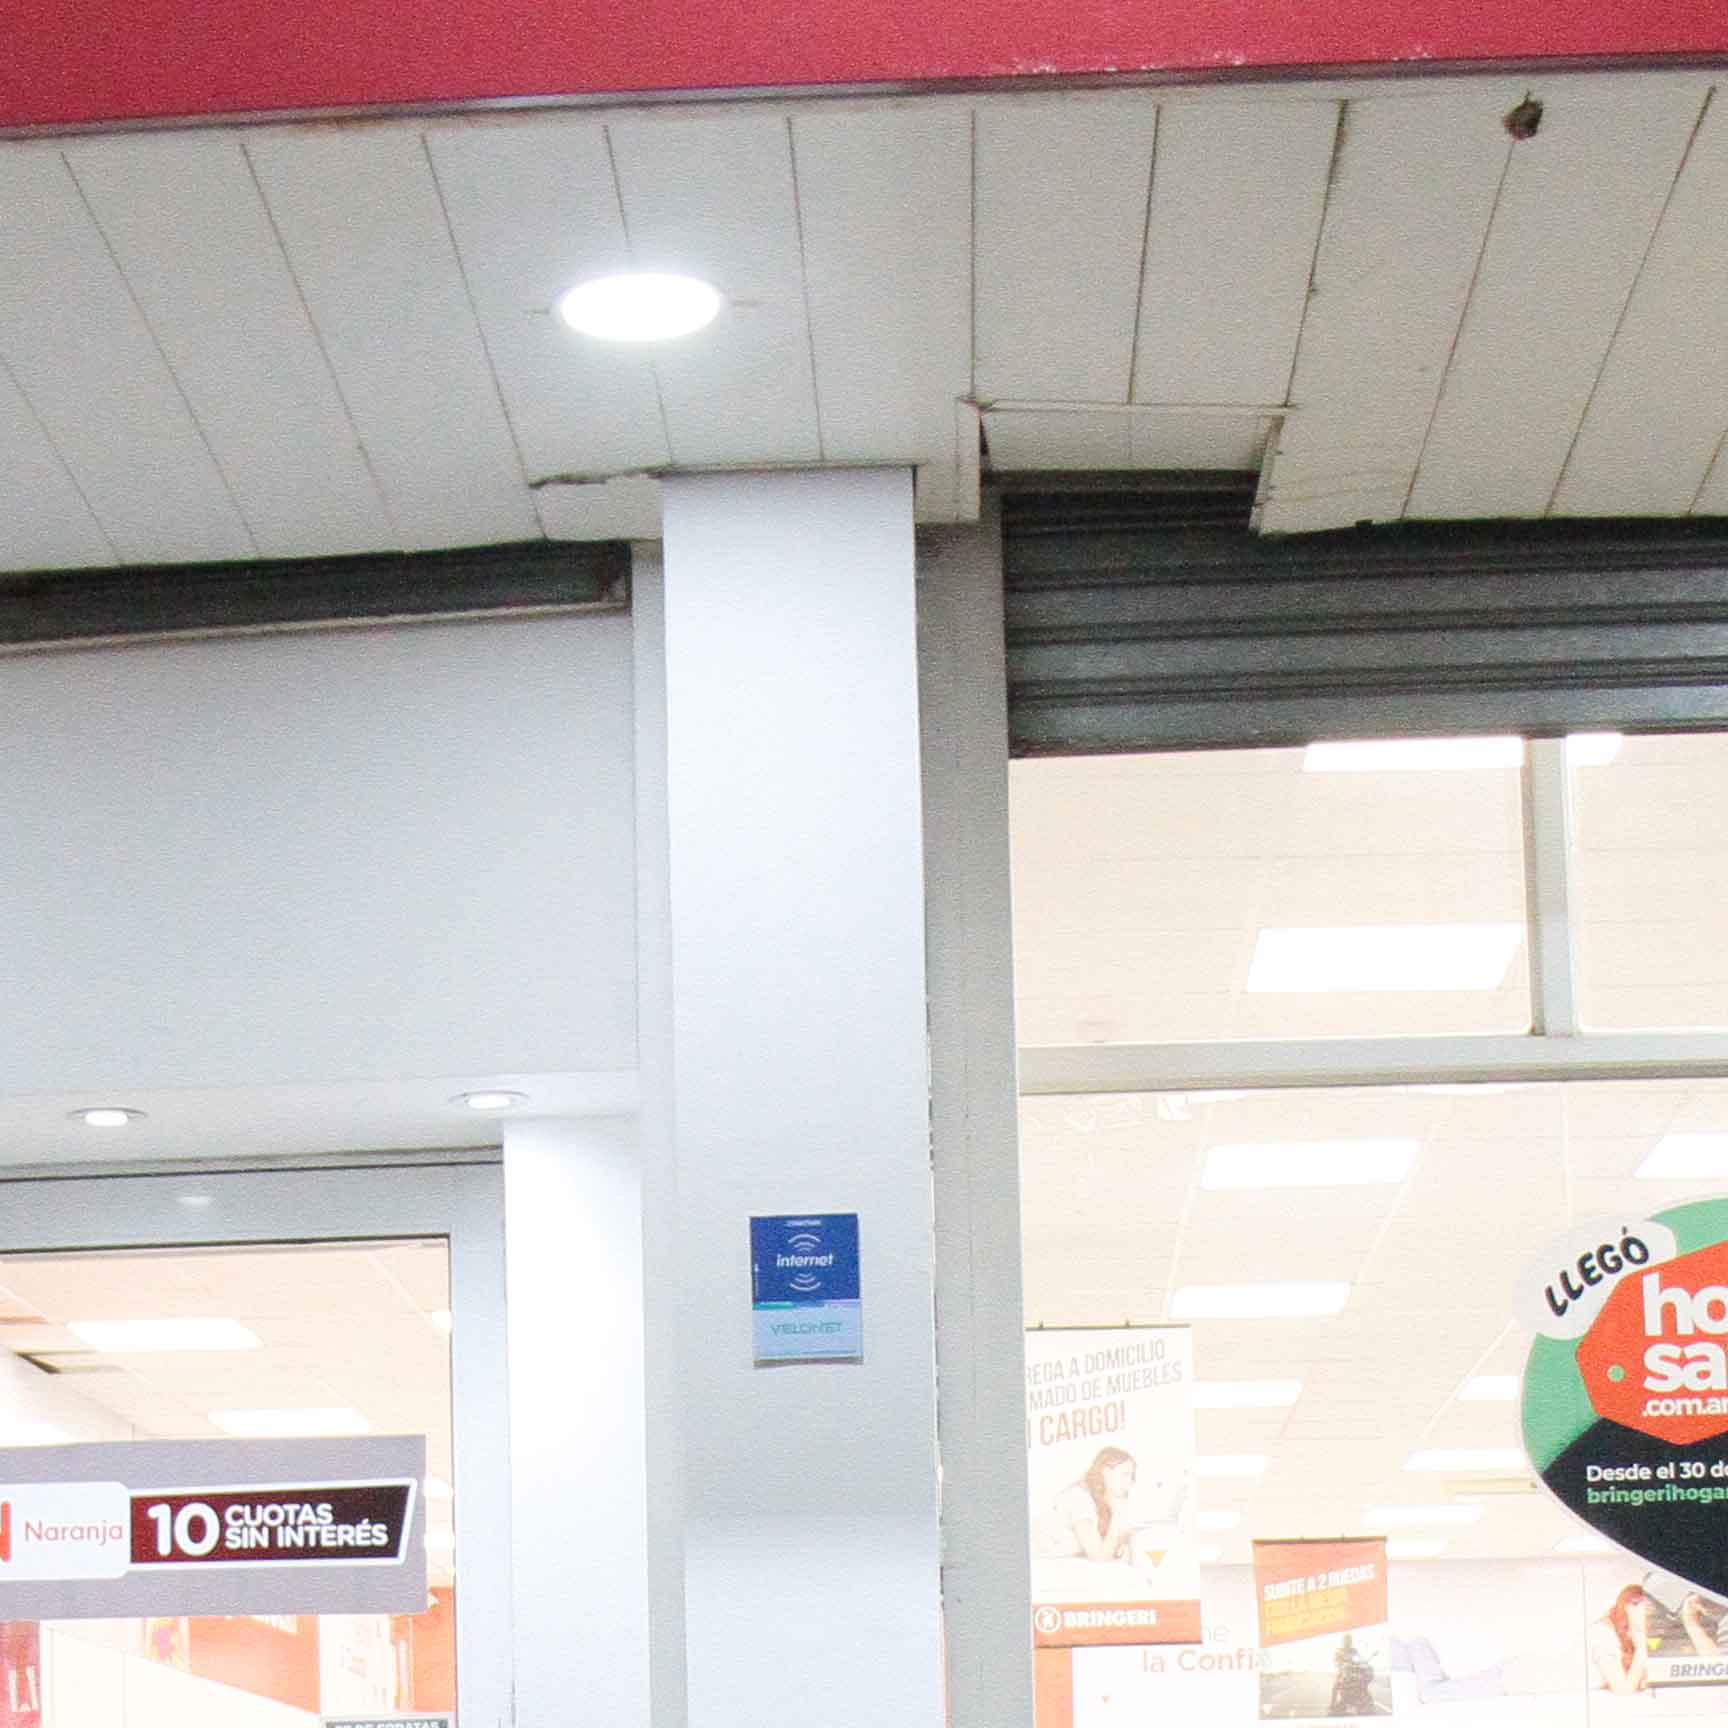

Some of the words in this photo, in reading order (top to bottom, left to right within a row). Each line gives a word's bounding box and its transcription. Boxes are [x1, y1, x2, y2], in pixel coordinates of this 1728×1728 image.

[776, 1253, 835, 1268] internet
[1544, 1225, 1650, 1318] LLEGÓ
[1069, 1356, 1081, 1378] A
[1085, 1337, 1166, 1375] DOMICILIO
[1082, 1377, 1103, 1401] DE
[1106, 1360, 1183, 1395] MUEBLES
[1039, 1399, 1127, 1447] CARGO!
[1585, 1463, 1652, 1482] Desde
[1655, 1461, 1675, 1480] el
[1679, 1460, 1705, 1480] 30
[23, 1518, 124, 1542] Naranja
[146, 1501, 223, 1558] 10
[224, 1502, 334, 1525] CUOTAS
[224, 1526, 269, 1549] SIN
[276, 1517, 390, 1547] INTERÉS
[1063, 1608, 1157, 1629] BRINGERI
